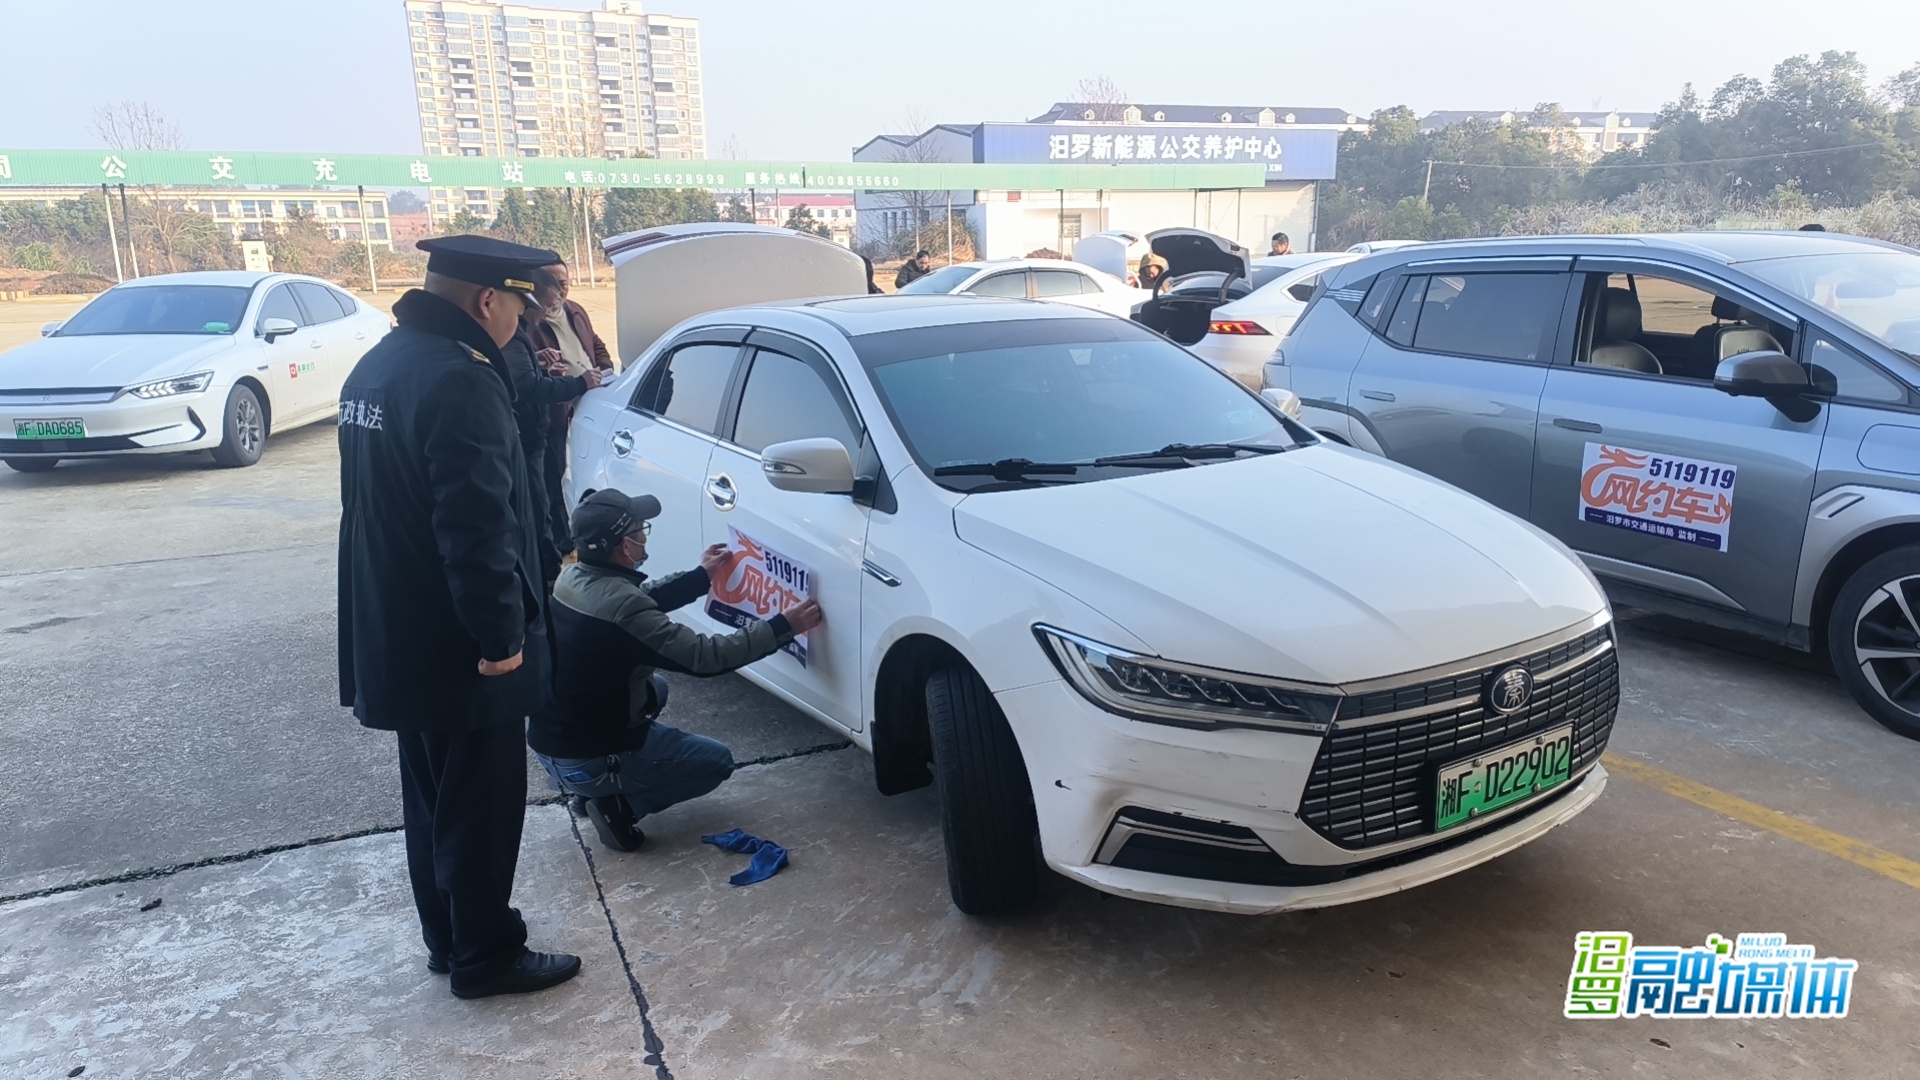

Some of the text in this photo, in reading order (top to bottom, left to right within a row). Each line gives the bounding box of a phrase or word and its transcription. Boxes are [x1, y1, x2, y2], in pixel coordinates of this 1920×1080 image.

[1049, 134, 1282, 160] 汨罗新能源公交养护中心
[1650, 458, 1735, 489] 5119119
[1594, 470, 1730, 524] 网约车
[1606, 514, 1674, 538] 汨罗市交通运输局
